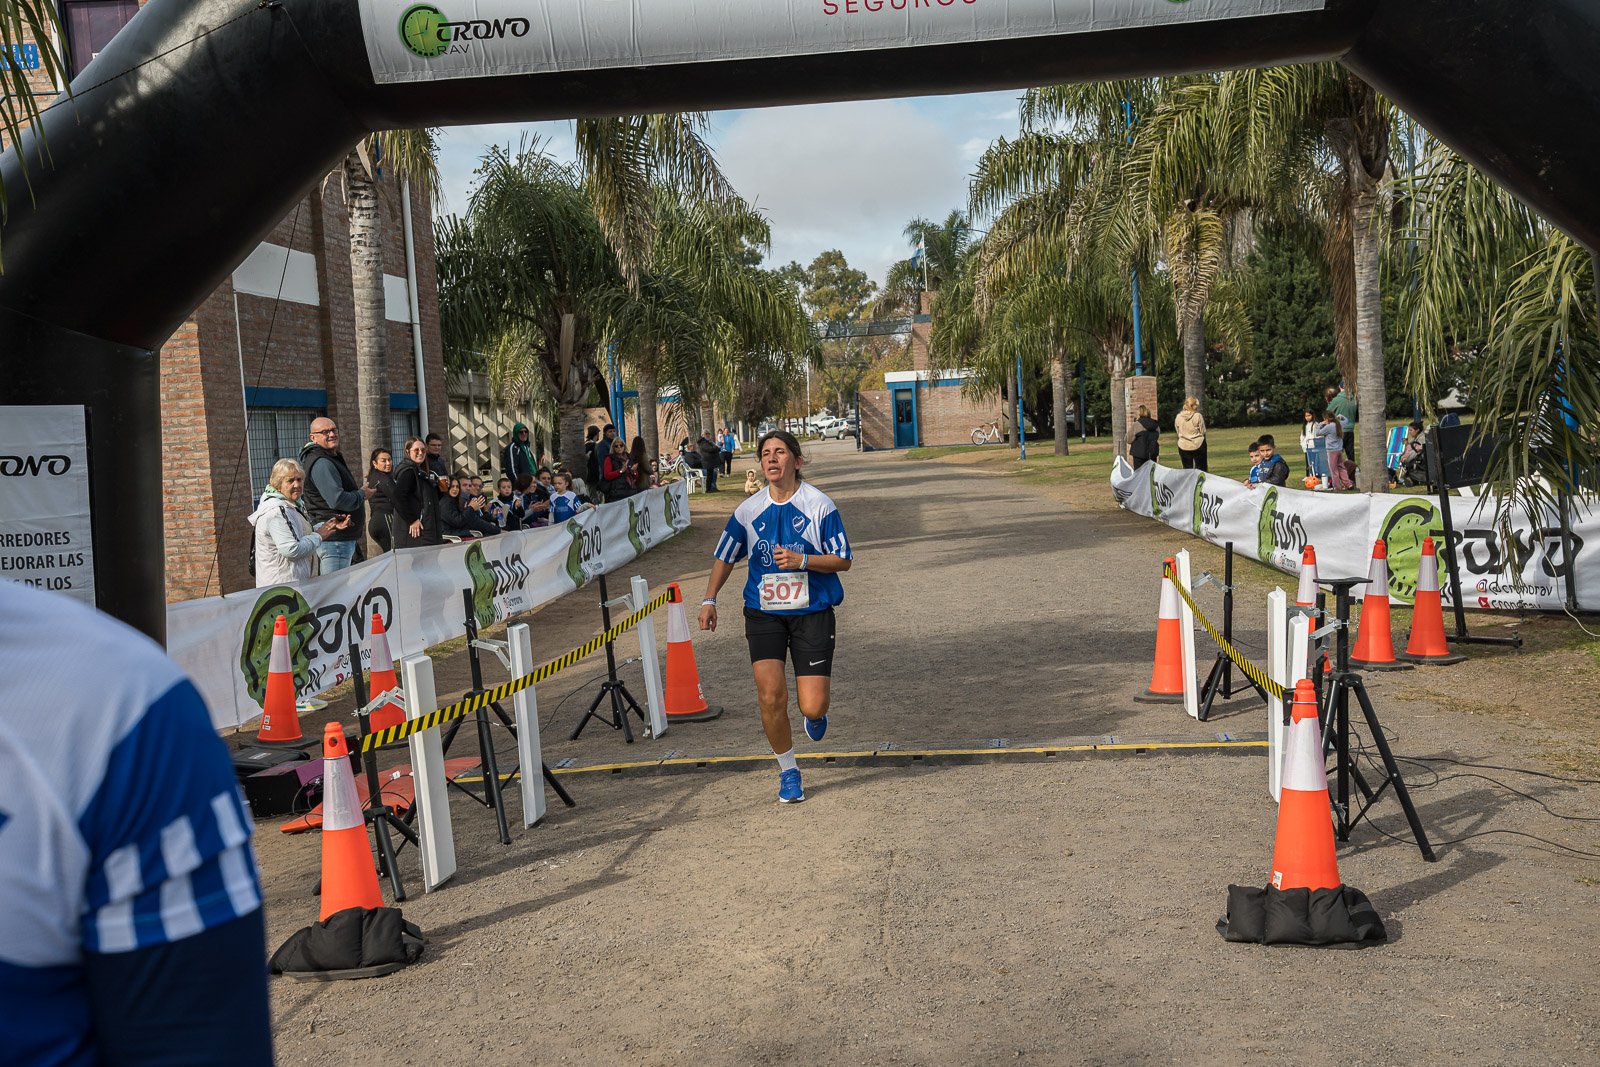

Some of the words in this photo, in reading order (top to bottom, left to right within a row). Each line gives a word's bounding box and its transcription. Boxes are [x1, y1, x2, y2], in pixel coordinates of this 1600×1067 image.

[436, 17, 530, 42] CRONO
[437, 44, 470, 55] RAV
[0, 455, 71, 476] ONO
[0, 554, 55, 571] EJORAR
[59, 552, 84, 567] LAS
[758, 539, 773, 567] 3
[47, 575, 72, 590] LOS
[763, 581, 803, 601] 507
